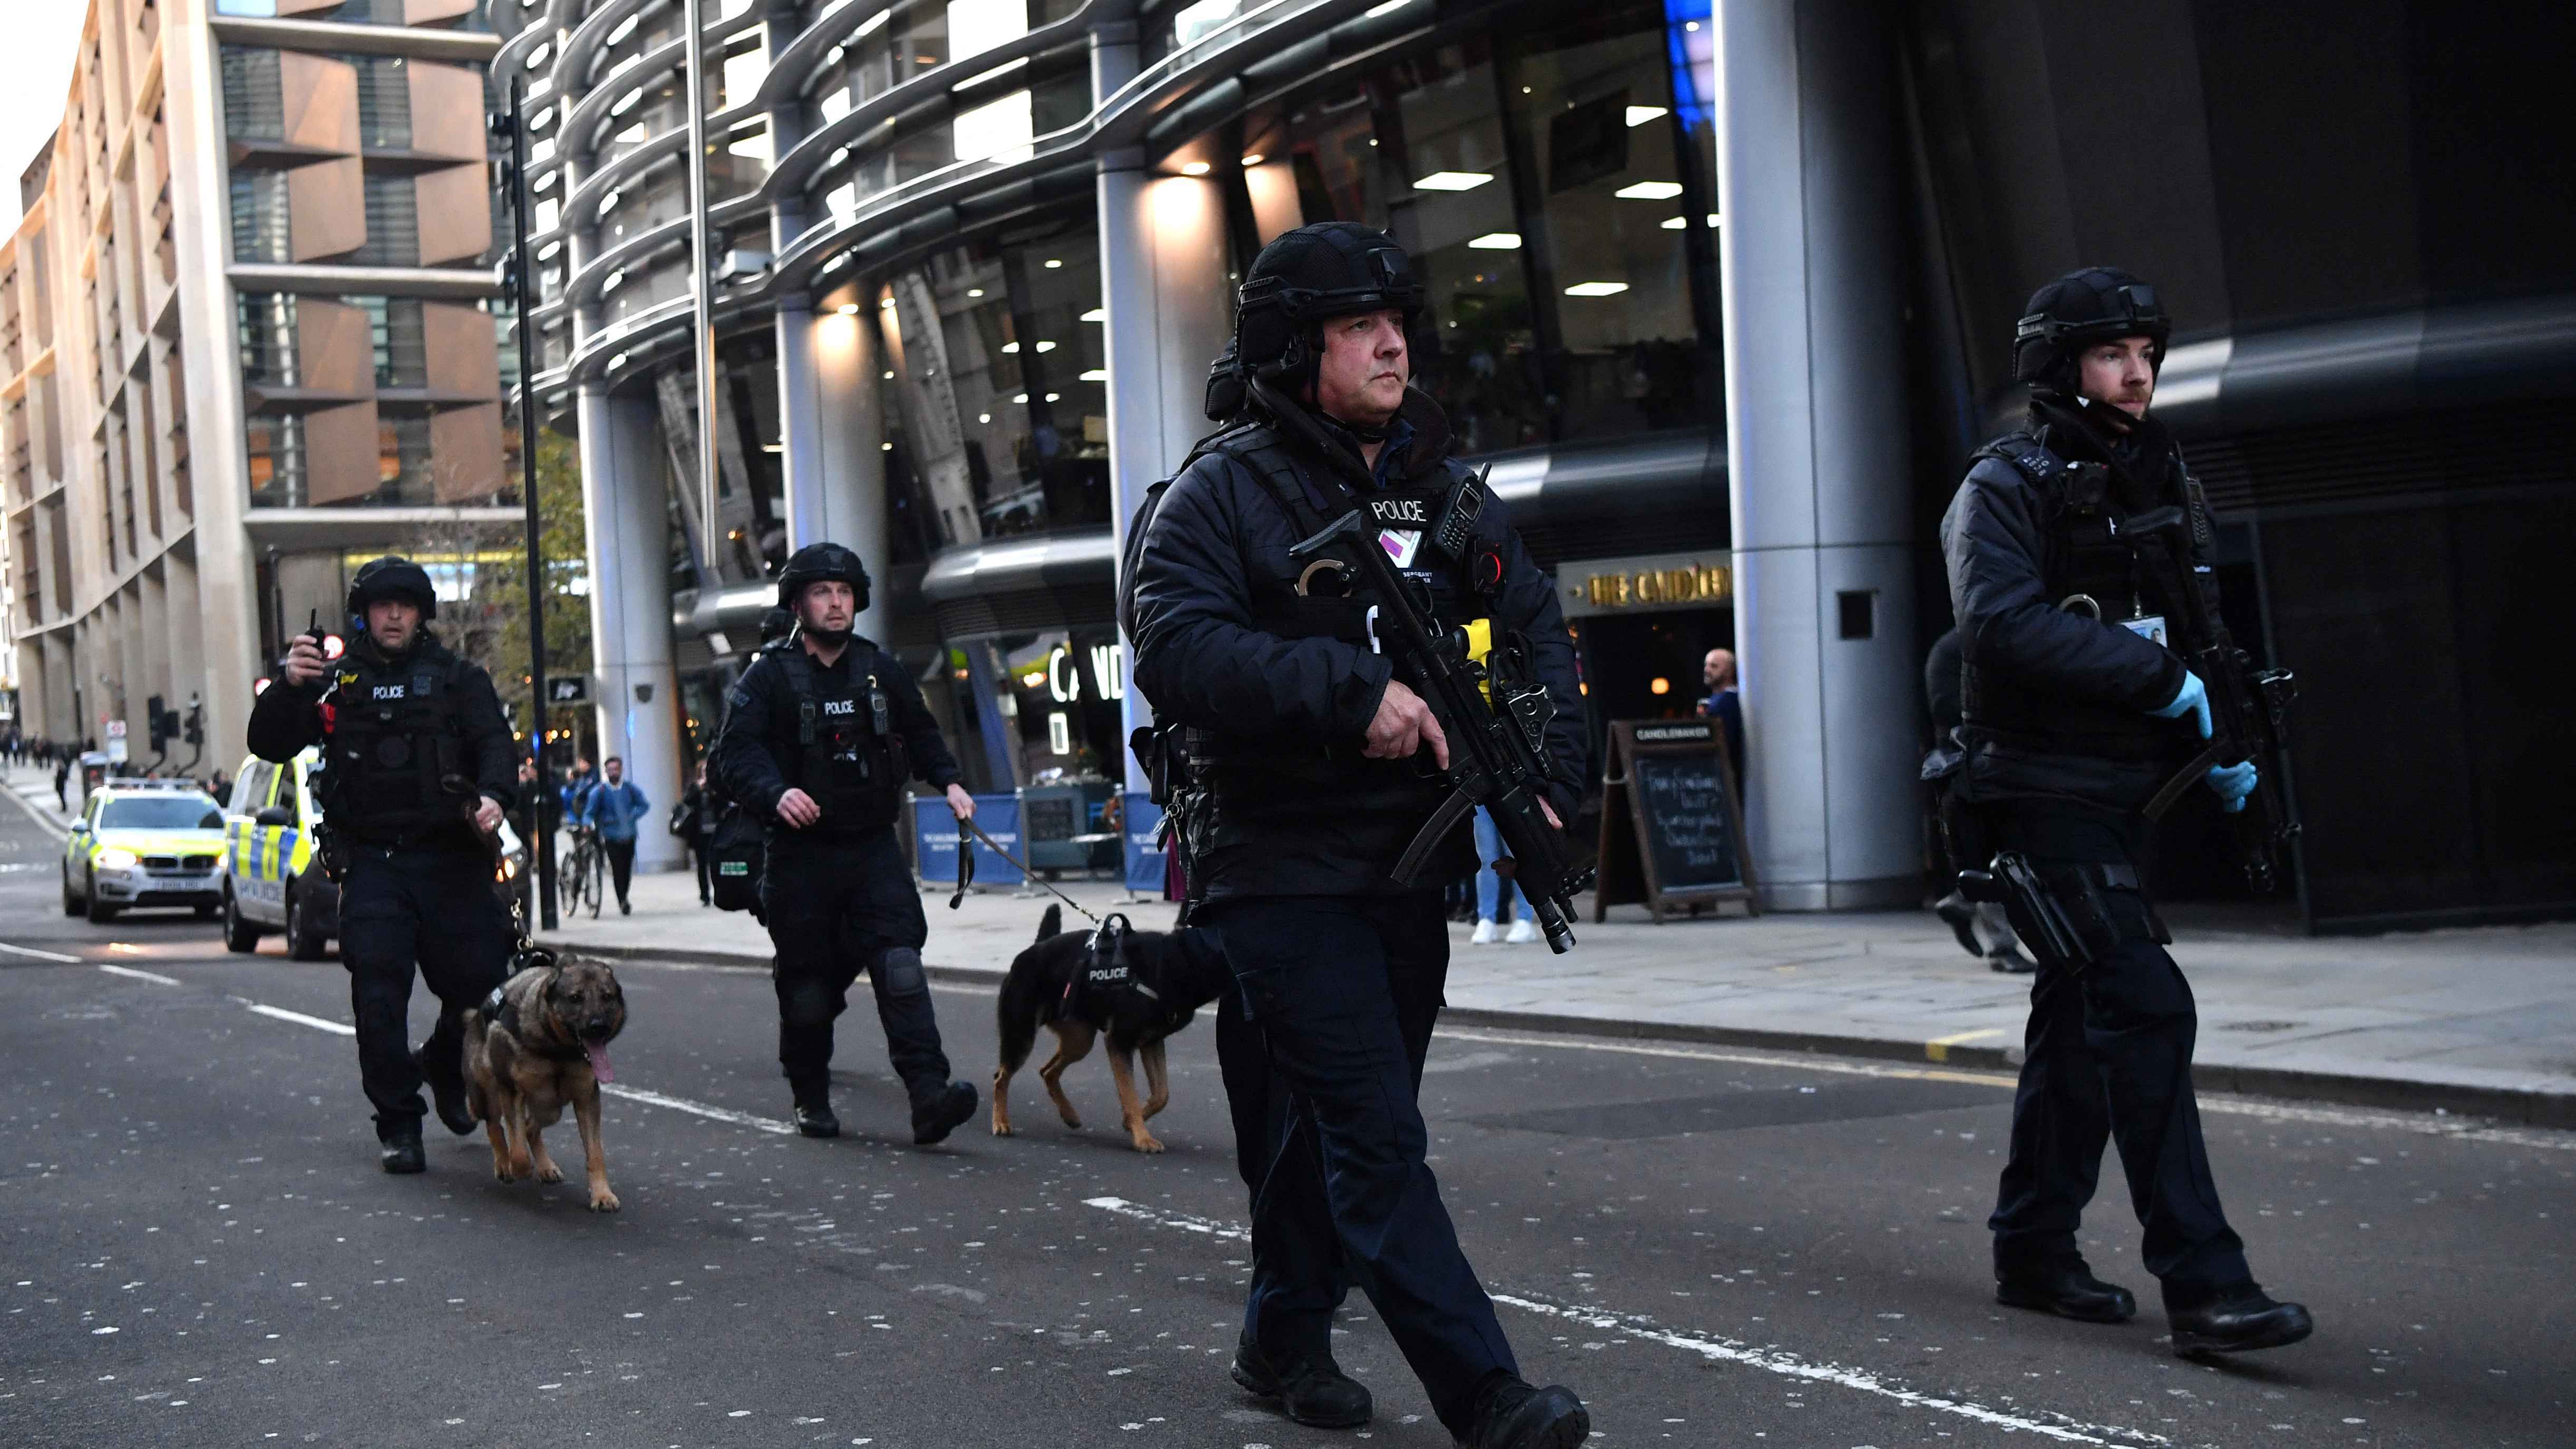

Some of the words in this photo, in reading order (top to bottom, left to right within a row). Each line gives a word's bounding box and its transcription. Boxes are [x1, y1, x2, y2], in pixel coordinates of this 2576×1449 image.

[1371, 500, 1427, 522] POLICE
[373, 685, 404, 700] POLICE
[824, 699, 855, 716] POLICE
[1089, 967, 1129, 981] POLICE
